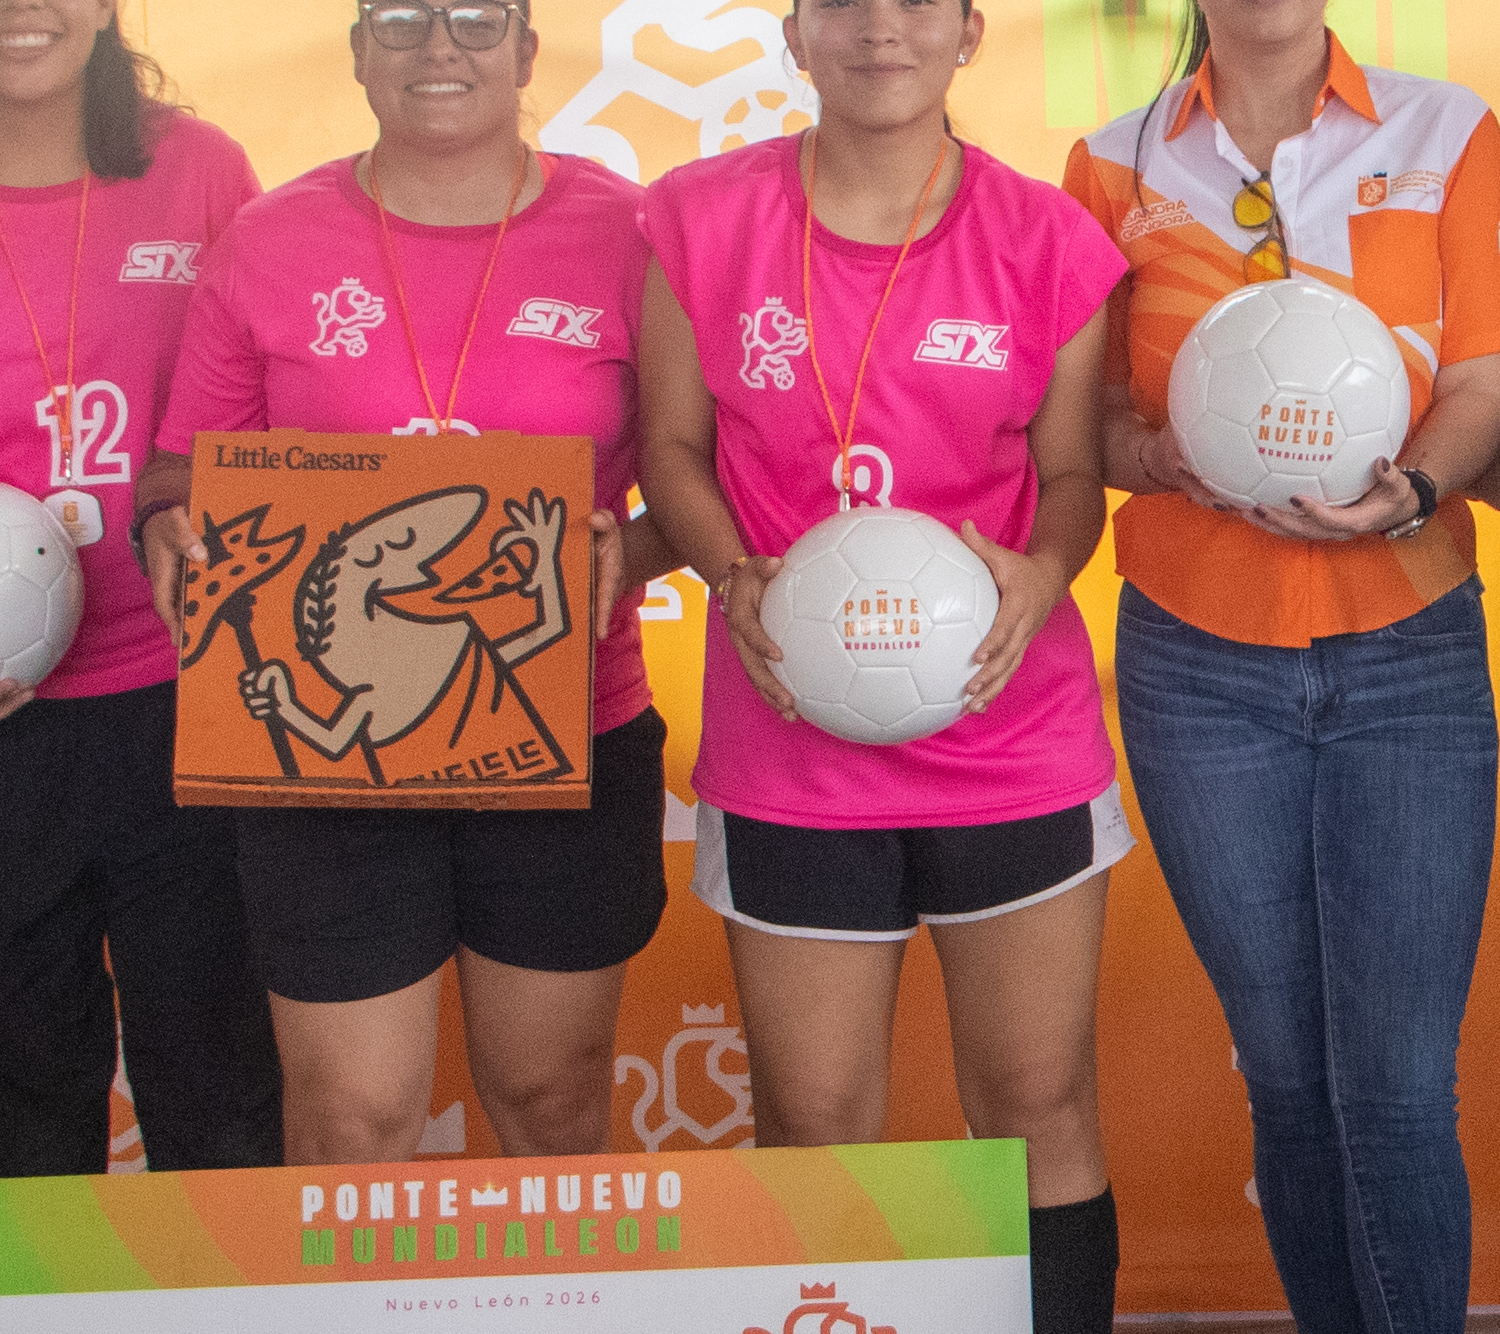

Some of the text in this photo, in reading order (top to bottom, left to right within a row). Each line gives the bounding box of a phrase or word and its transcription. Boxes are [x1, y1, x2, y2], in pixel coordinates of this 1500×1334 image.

[119, 240, 202, 285] SIX
[506, 297, 604, 349] SIX
[913, 318, 1010, 371] SIX
[1260, 403, 1335, 428] PONTE
[35, 380, 132, 487] 12
[1258, 424, 1334, 447] NUEVO
[214, 445, 281, 470] Little
[844, 597, 920, 618] PONTE
[844, 619, 922, 639] NUEVO
[301, 1169, 683, 1224] PONTE NUEVO
[385, 1289, 603, 1313] Nuevo León 2026
